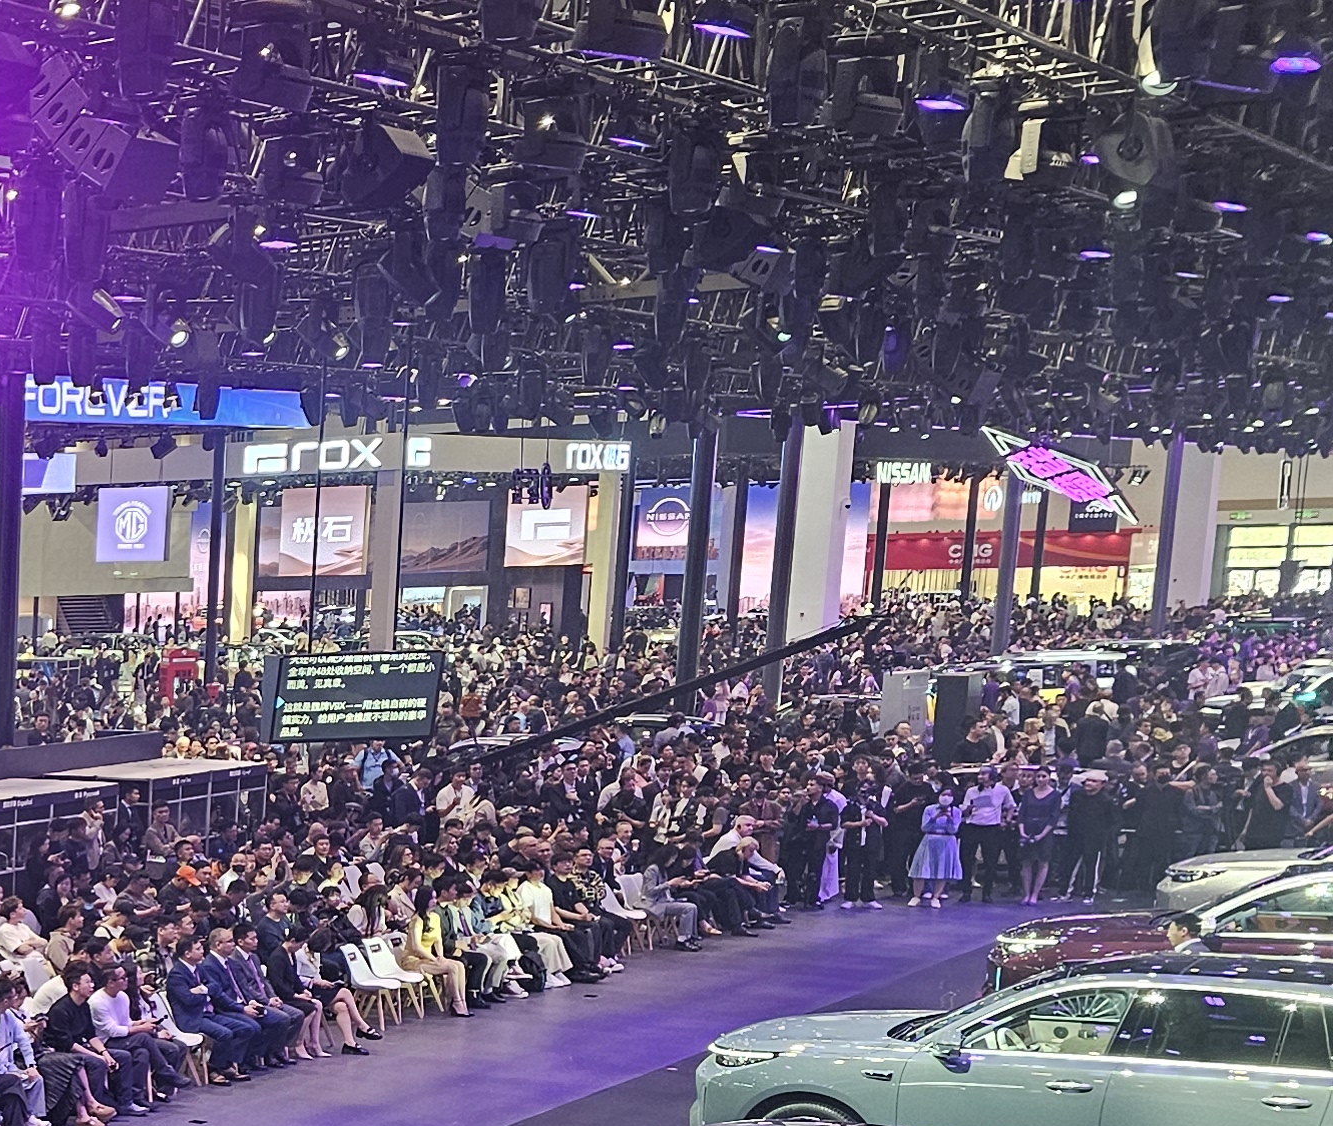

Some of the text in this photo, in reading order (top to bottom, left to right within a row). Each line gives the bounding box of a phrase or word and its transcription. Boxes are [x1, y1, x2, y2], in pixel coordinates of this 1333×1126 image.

[877, 462, 932, 484] NISSAN
[117, 510, 146, 540] MG
[292, 515, 354, 543] 极石
